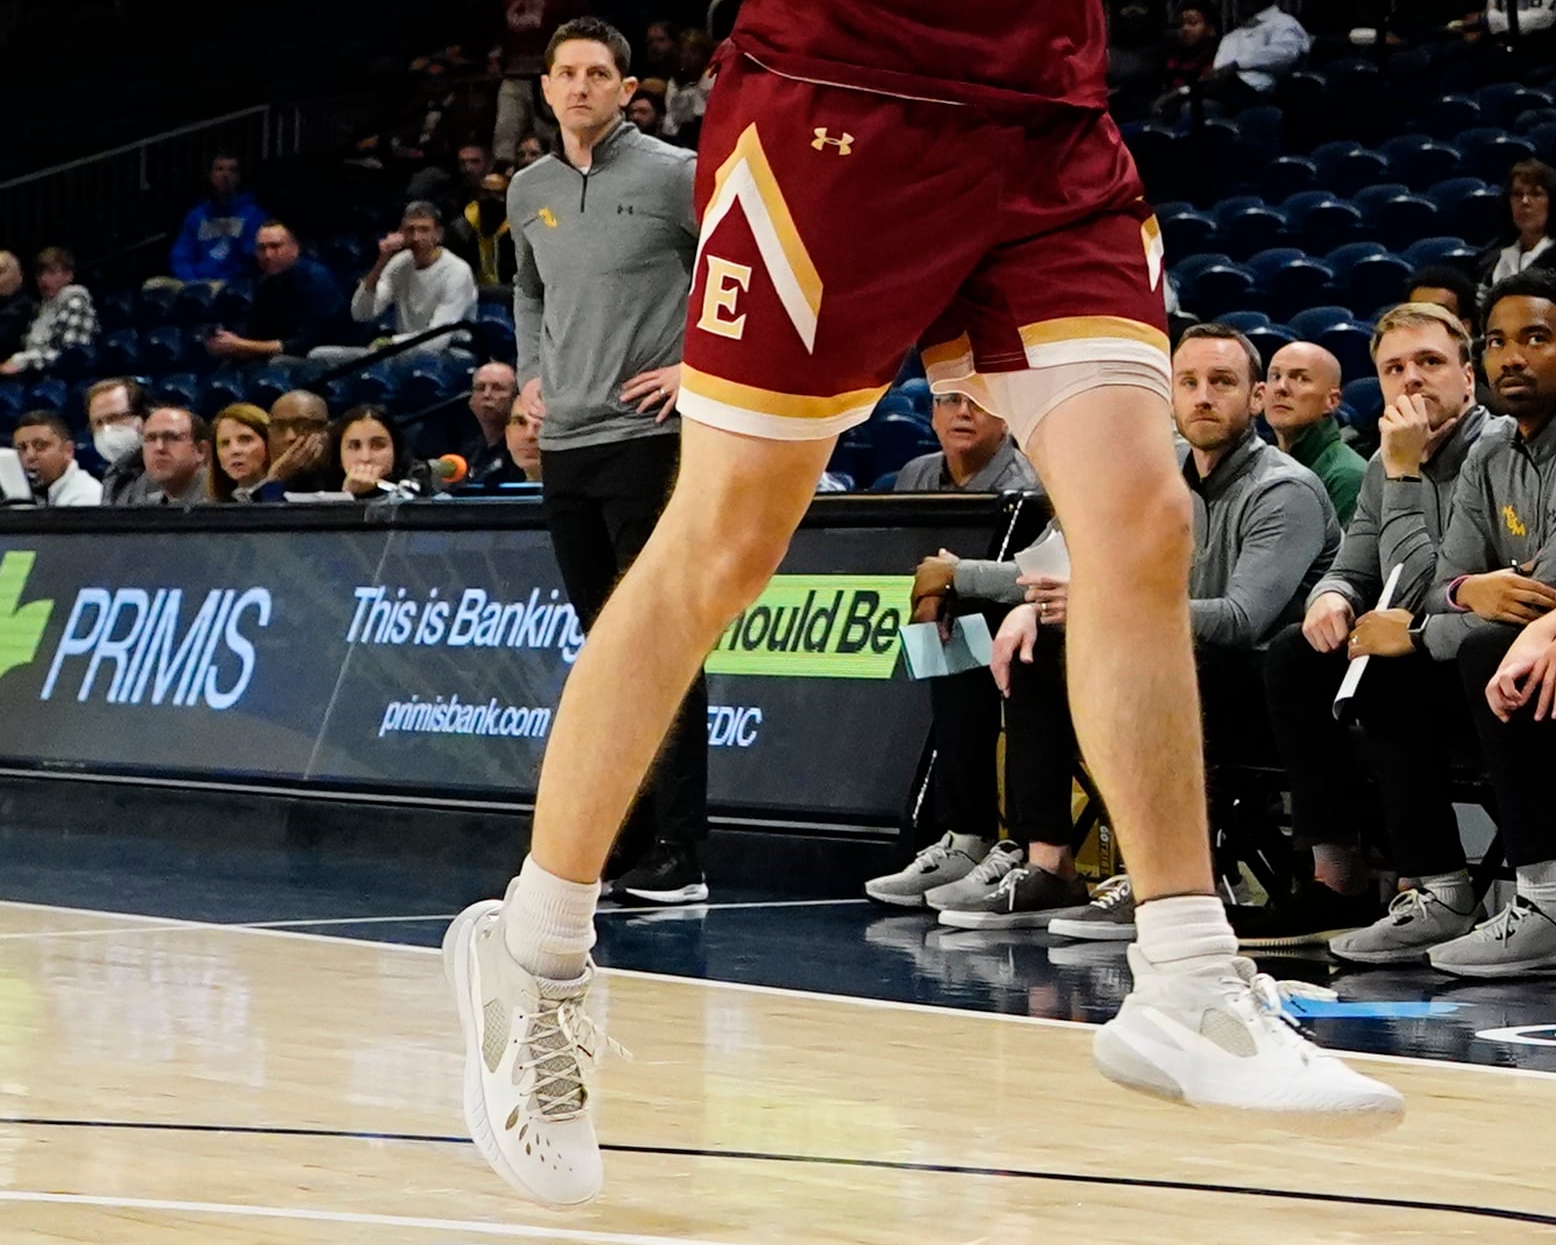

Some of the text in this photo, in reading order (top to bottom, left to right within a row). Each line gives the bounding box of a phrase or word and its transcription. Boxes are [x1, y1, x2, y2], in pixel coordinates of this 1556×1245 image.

[696, 253, 753, 341] E
[40, 587, 272, 709] PRIMIS
[347, 585, 417, 645] This
[414, 587, 450, 645] is
[447, 587, 587, 664] Banking
[836, 589, 900, 654] Be
[379, 694, 551, 738] primisbank.com
